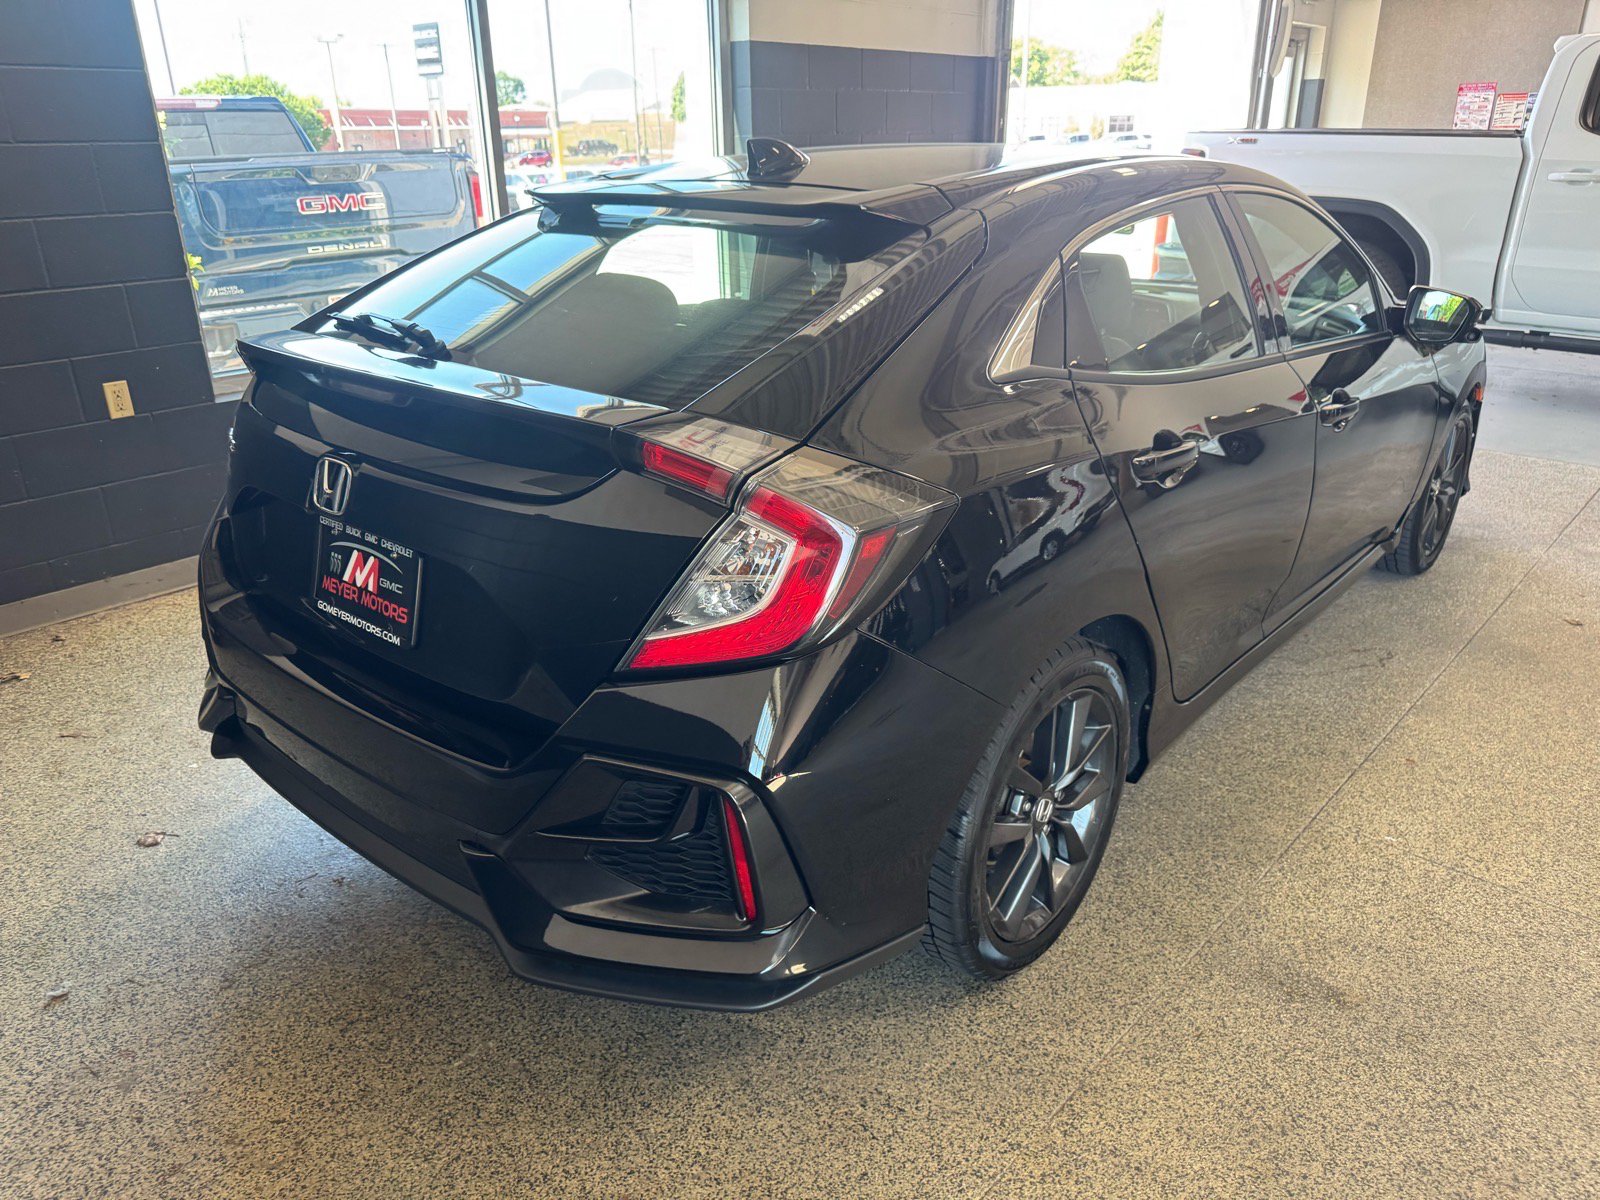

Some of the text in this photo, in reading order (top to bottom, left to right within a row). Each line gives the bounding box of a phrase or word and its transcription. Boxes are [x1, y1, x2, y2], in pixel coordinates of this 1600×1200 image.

[296, 191, 386, 215] GMC
[307, 239, 387, 254] DENALI
[319, 515, 414, 559] CERTIFIED BUICK GMC CHEVROLET
[321, 574, 409, 624] MEYER MOTORS
[379, 578, 404, 594] GMC
[317, 600, 401, 646] GOMEYERMOTORS.COM
